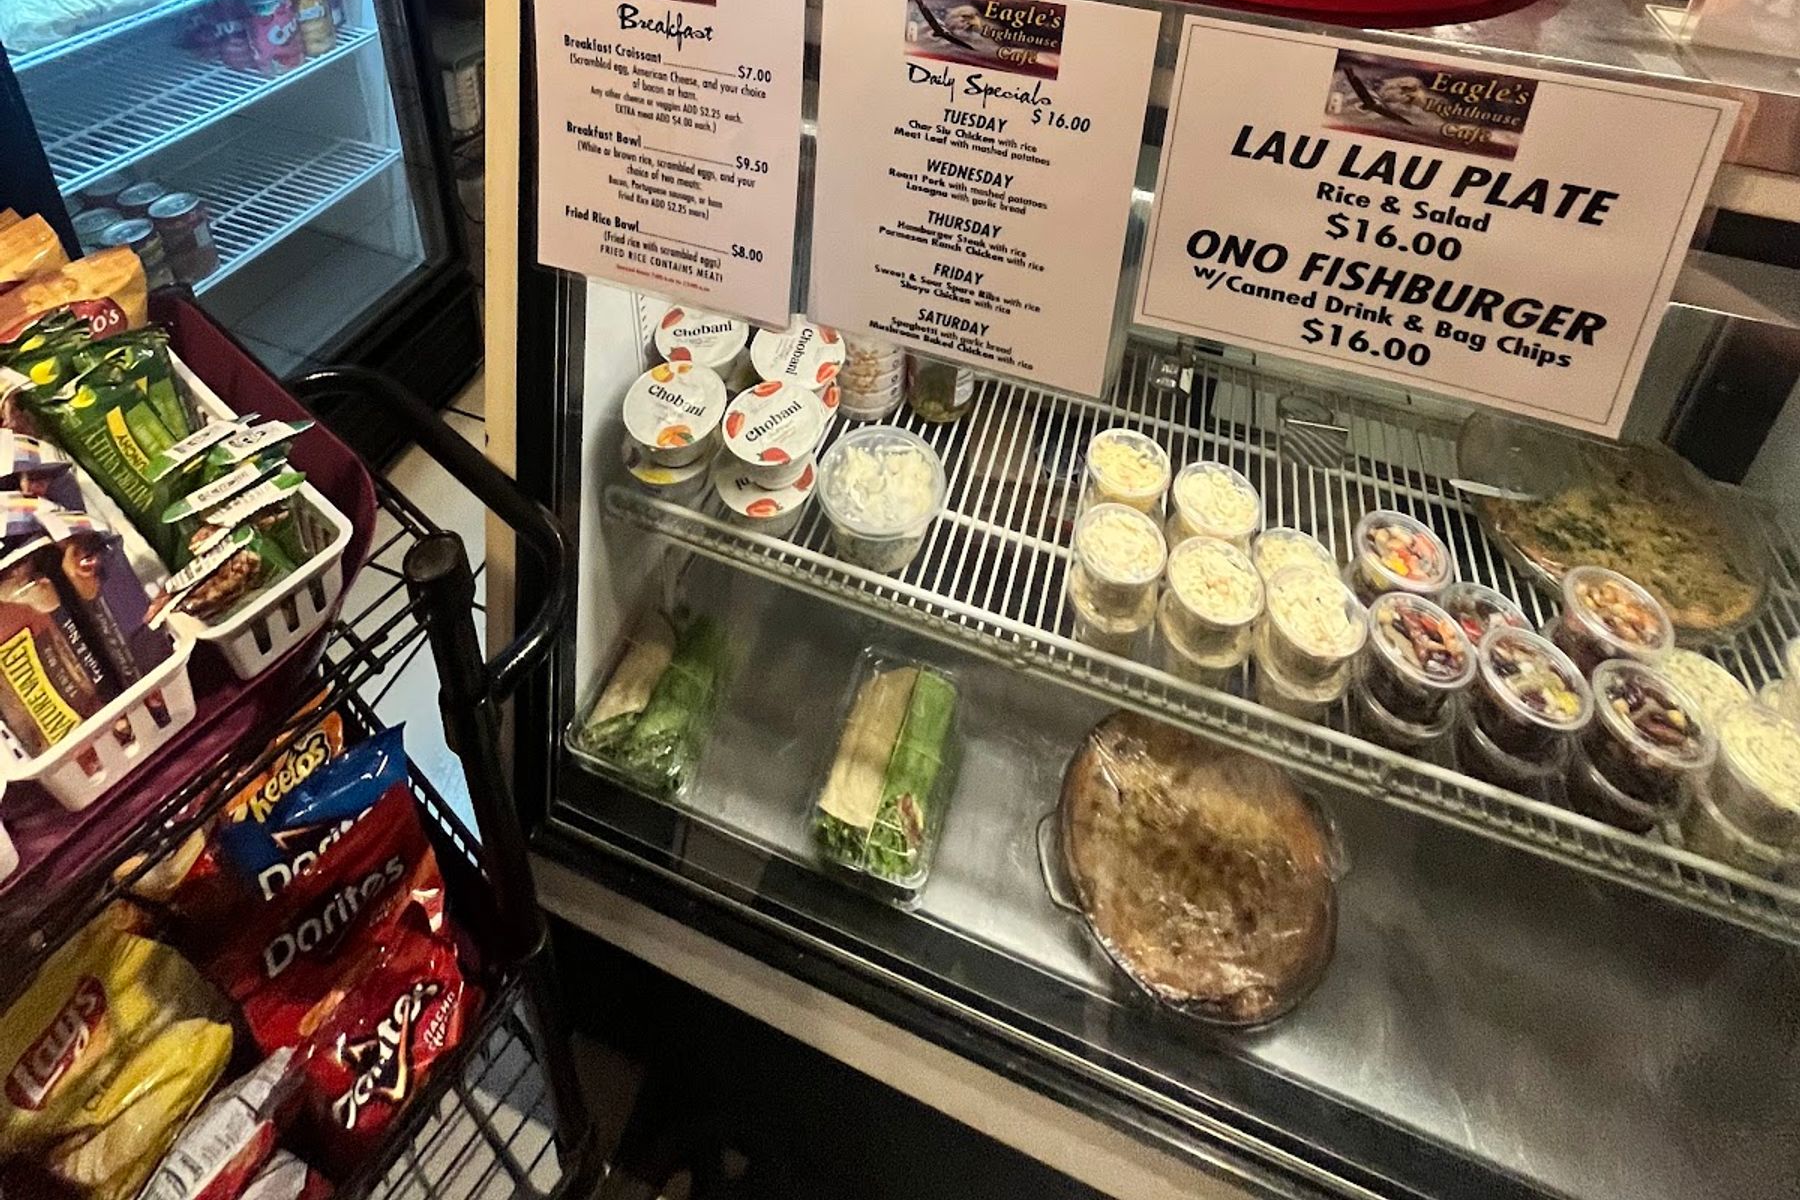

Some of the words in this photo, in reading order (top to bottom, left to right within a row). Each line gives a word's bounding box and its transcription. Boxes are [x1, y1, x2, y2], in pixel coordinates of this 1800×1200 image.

[616, 2, 712, 51] Breakfast
[984, 0, 1063, 29] Eagle's
[982, 25, 1059, 48] Lighthouse
[563, 34, 611, 54] Breakfast
[615, 43, 661, 63] Croissant
[737, 64, 771, 83] $7.00
[906, 62, 955, 102] Daily
[963, 73, 1051, 108] Specials
[1428, 72, 1531, 106] Eagle's
[943, 108, 1007, 133] TUESDAY
[1423, 98, 1523, 128] Lighthouse
[566, 120, 612, 140] Breakfast
[616, 131, 641, 147] Bowl
[736, 155, 768, 173] $9.50
[893, 126, 920, 139] Meat
[924, 132, 947, 144] Loaf
[949, 139, 968, 149] with
[971, 144, 1007, 157] mashed
[1010, 152, 1049, 166] potatoes
[908, 119, 932, 131] Char
[935, 124, 951, 135] Siu
[954, 128, 995, 144] Chicken
[997, 139, 1017, 148] with
[1019, 142, 1037, 152] rice
[888, 167, 917, 181] Roast
[921, 174, 945, 187] Pork
[948, 182, 967, 191] with
[970, 187, 1005, 200] mashed
[1007, 195, 1047, 209] potatoes
[927, 158, 1013, 188] WEDNESDAY
[1230, 124, 1329, 169] LAU
[1337, 143, 1442, 190] LAU
[1450, 165, 1619, 226] PLATE
[905, 181, 947, 197] Lasagna
[950, 192, 969, 202] with
[971, 197, 996, 208] garlic
[999, 200, 1026, 214] bread
[1316, 181, 1370, 208] Rice
[1379, 195, 1400, 215] &
[1412, 200, 1491, 232] Salad
[565, 204, 589, 220] Fried
[592, 210, 611, 226] Rice
[614, 215, 638, 232] Bowl
[731, 243, 762, 262] $8.00
[897, 220, 953, 240] Hamburger
[956, 233, 985, 248] Steak
[988, 244, 1007, 253] with
[1010, 248, 1026, 257] rice
[928, 210, 1002, 238] THURSDAY
[1324, 212, 1462, 261] $16.00
[600, 244, 624, 257] FRIED
[628, 250, 645, 263] RICE
[649, 256, 692, 274] CONTAINS
[878, 225, 928, 244] Parmesan
[931, 237, 961, 251] Ranch
[965, 245, 1003, 262] Chicken
[1006, 257, 1025, 267] with
[1027, 262, 1044, 271] rice
[874, 264, 905, 278] Sweet
[920, 275, 942, 287] Sour
[946, 281, 974, 296] Spare
[977, 289, 1000, 302] Ribs
[1003, 298, 1021, 307] with
[1024, 303, 1040, 312] rice
[933, 262, 983, 285] FRIDAY
[1186, 229, 1288, 273] ONO
[1298, 251, 1607, 346] FISHBURGER
[900, 279, 929, 294] Shoyu
[933, 288, 970, 304] Chicken
[974, 300, 992, 309] with
[994, 305, 1010, 314] rice
[1193, 265, 1317, 308] w/Canned
[1324, 295, 1393, 326] Drink
[1403, 314, 1423, 333] &
[1434, 319, 1486, 351] Bag
[1496, 335, 1571, 367] Chips
[673, 320, 733, 337] Chobani
[889, 316, 938, 339] Spaghetti
[940, 331, 958, 343] with
[917, 308, 989, 336] SATURDAY
[1300, 317, 1430, 366] $16.00
[785, 327, 814, 376] Chobani
[868, 319, 920, 339] Mushroom
[923, 334, 953, 348] Baked
[956, 341, 994, 359] Chicken
[997, 356, 1015, 365] with
[1017, 360, 1033, 370] rice
[649, 384, 706, 418] Chobani
[745, 401, 803, 443] Chobani
[115, 432, 146, 471] UNCHY
[61, 617, 81, 645] Nut
[0, 637, 39, 699] VALLEY
[82, 651, 105, 685] Fruit
[26, 689, 75, 743] NATURE
[263, 856, 405, 979] Doritos
